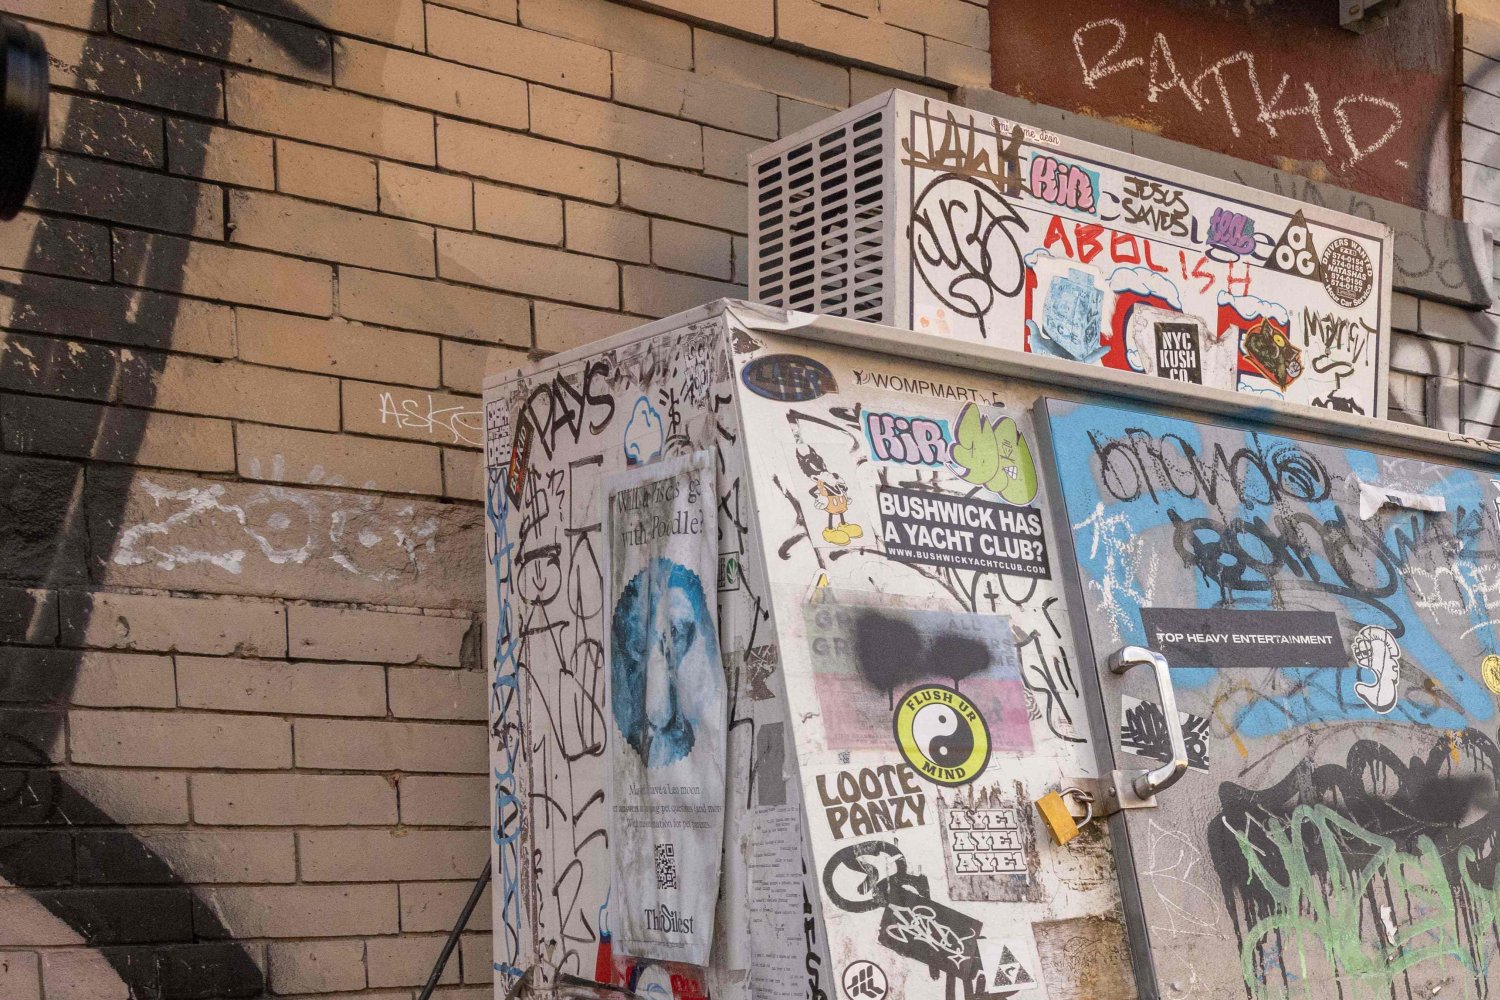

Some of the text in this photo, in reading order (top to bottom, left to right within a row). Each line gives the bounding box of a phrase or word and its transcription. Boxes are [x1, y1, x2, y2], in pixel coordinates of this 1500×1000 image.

[1043, 214, 1252, 297] ABOLISH
[1322, 238, 1373, 277] DRIVERS WANTED
[1328, 264, 1367, 281] NATASHAS
[1162, 331, 1192, 350] NYC
[1160, 350, 1196, 369] KUSH
[871, 372, 979, 401] WOMPMART
[879, 491, 1042, 537] BUSHWICK HAS
[884, 522, 1044, 562] A YACHT CLUB?
[888, 547, 1047, 575] WWW.BUSHWICKYACHTCLUB.COM
[1156, 631, 1333, 645] TOP HEAVY ENTERTAINMENT
[906, 690, 978, 724] FLUSH UR
[816, 763, 924, 808] LOOTE
[921, 760, 968, 781] MIND
[825, 793, 926, 840] PANZY
